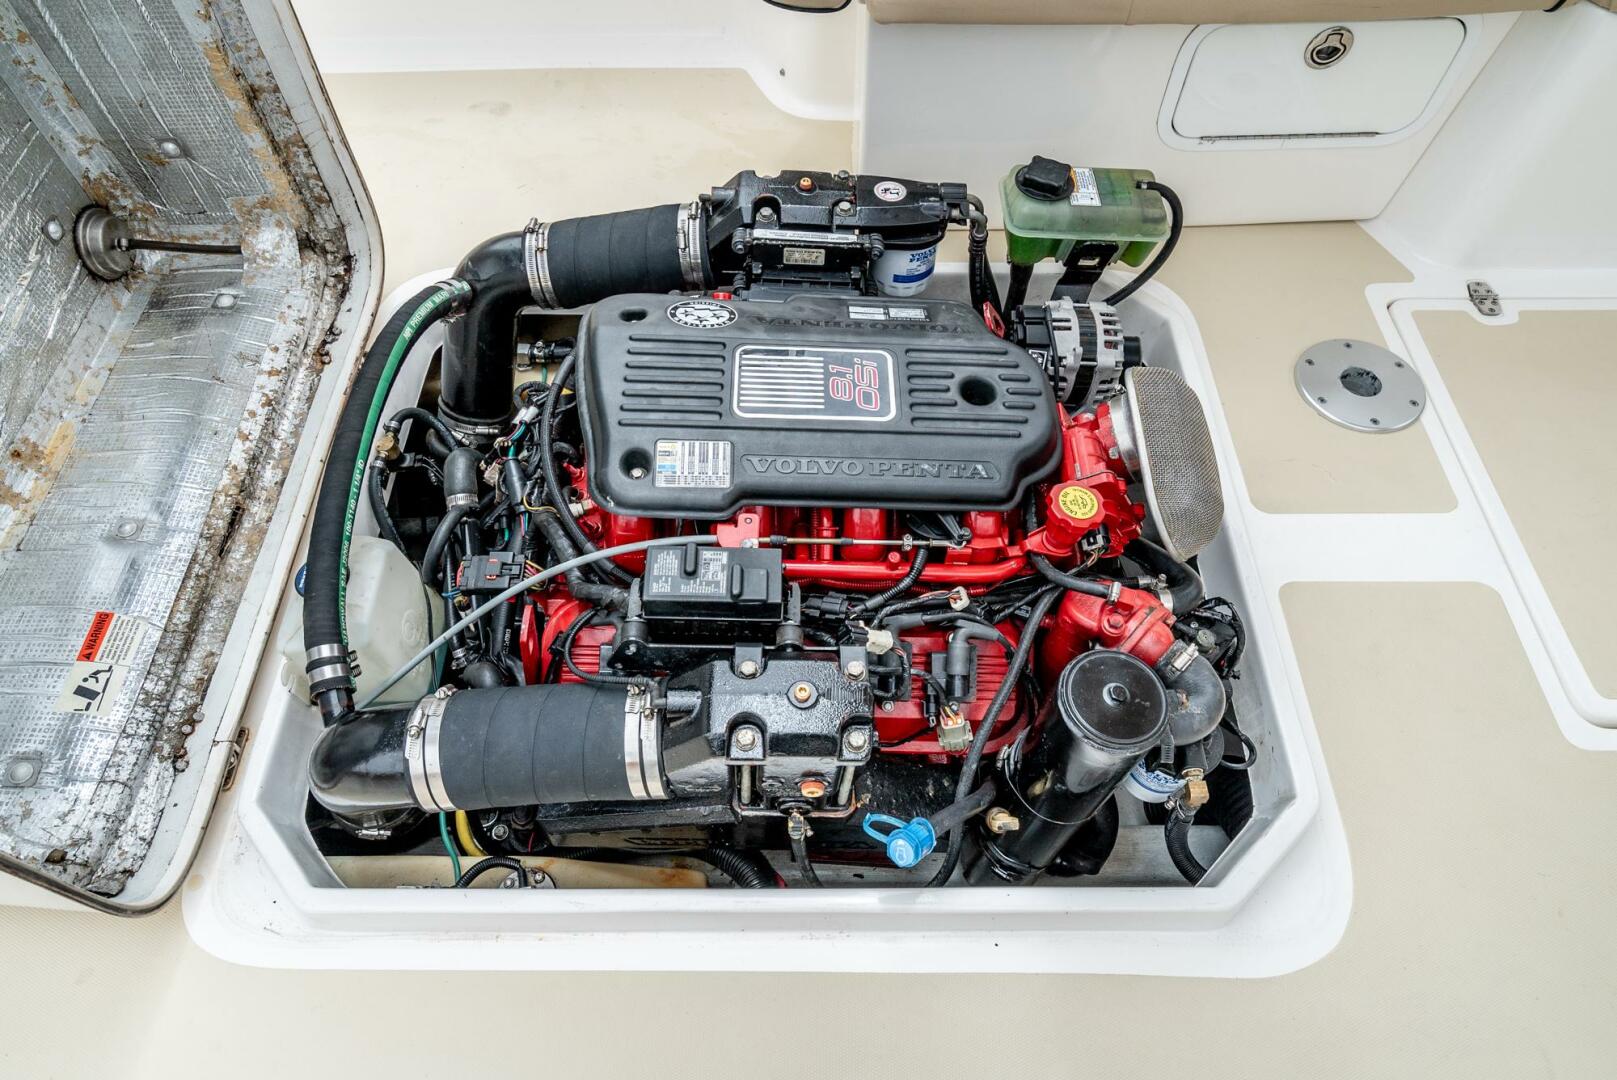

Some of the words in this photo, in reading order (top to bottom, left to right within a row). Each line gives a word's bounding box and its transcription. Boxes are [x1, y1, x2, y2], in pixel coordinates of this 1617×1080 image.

[410, 301, 434, 328] PREMIUM
[828, 364, 854, 402] 8.1
[747, 458, 865, 477] VOLVO
[868, 461, 994, 480] PENTA
[84, 613, 109, 651] WARNING
